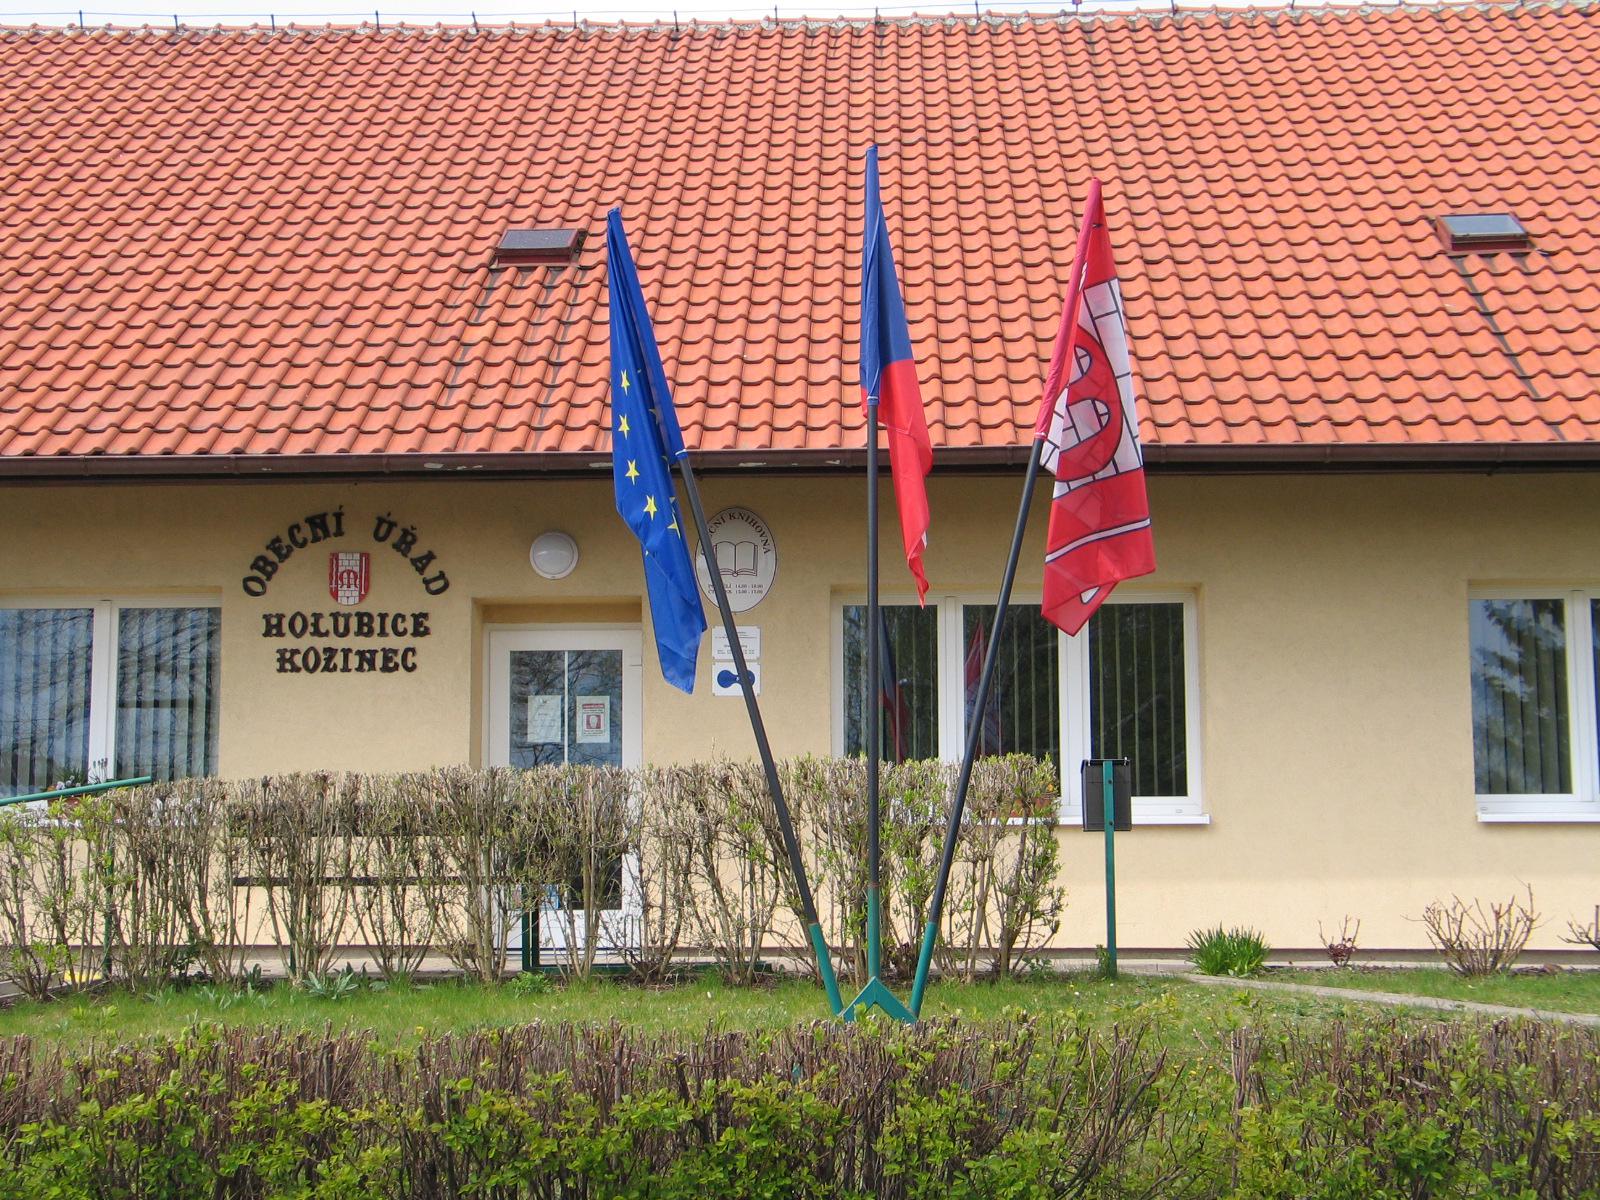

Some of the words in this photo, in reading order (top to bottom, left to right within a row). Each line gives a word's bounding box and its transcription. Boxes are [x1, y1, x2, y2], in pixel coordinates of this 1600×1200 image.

[728, 512, 771, 554] KNIHOVNA
[242, 505, 345, 597] OBECNÍ
[373, 512, 450, 596] ÚŘAD
[262, 611, 431, 639] HOLUBICE
[276, 646, 418, 674] KOZINEC
